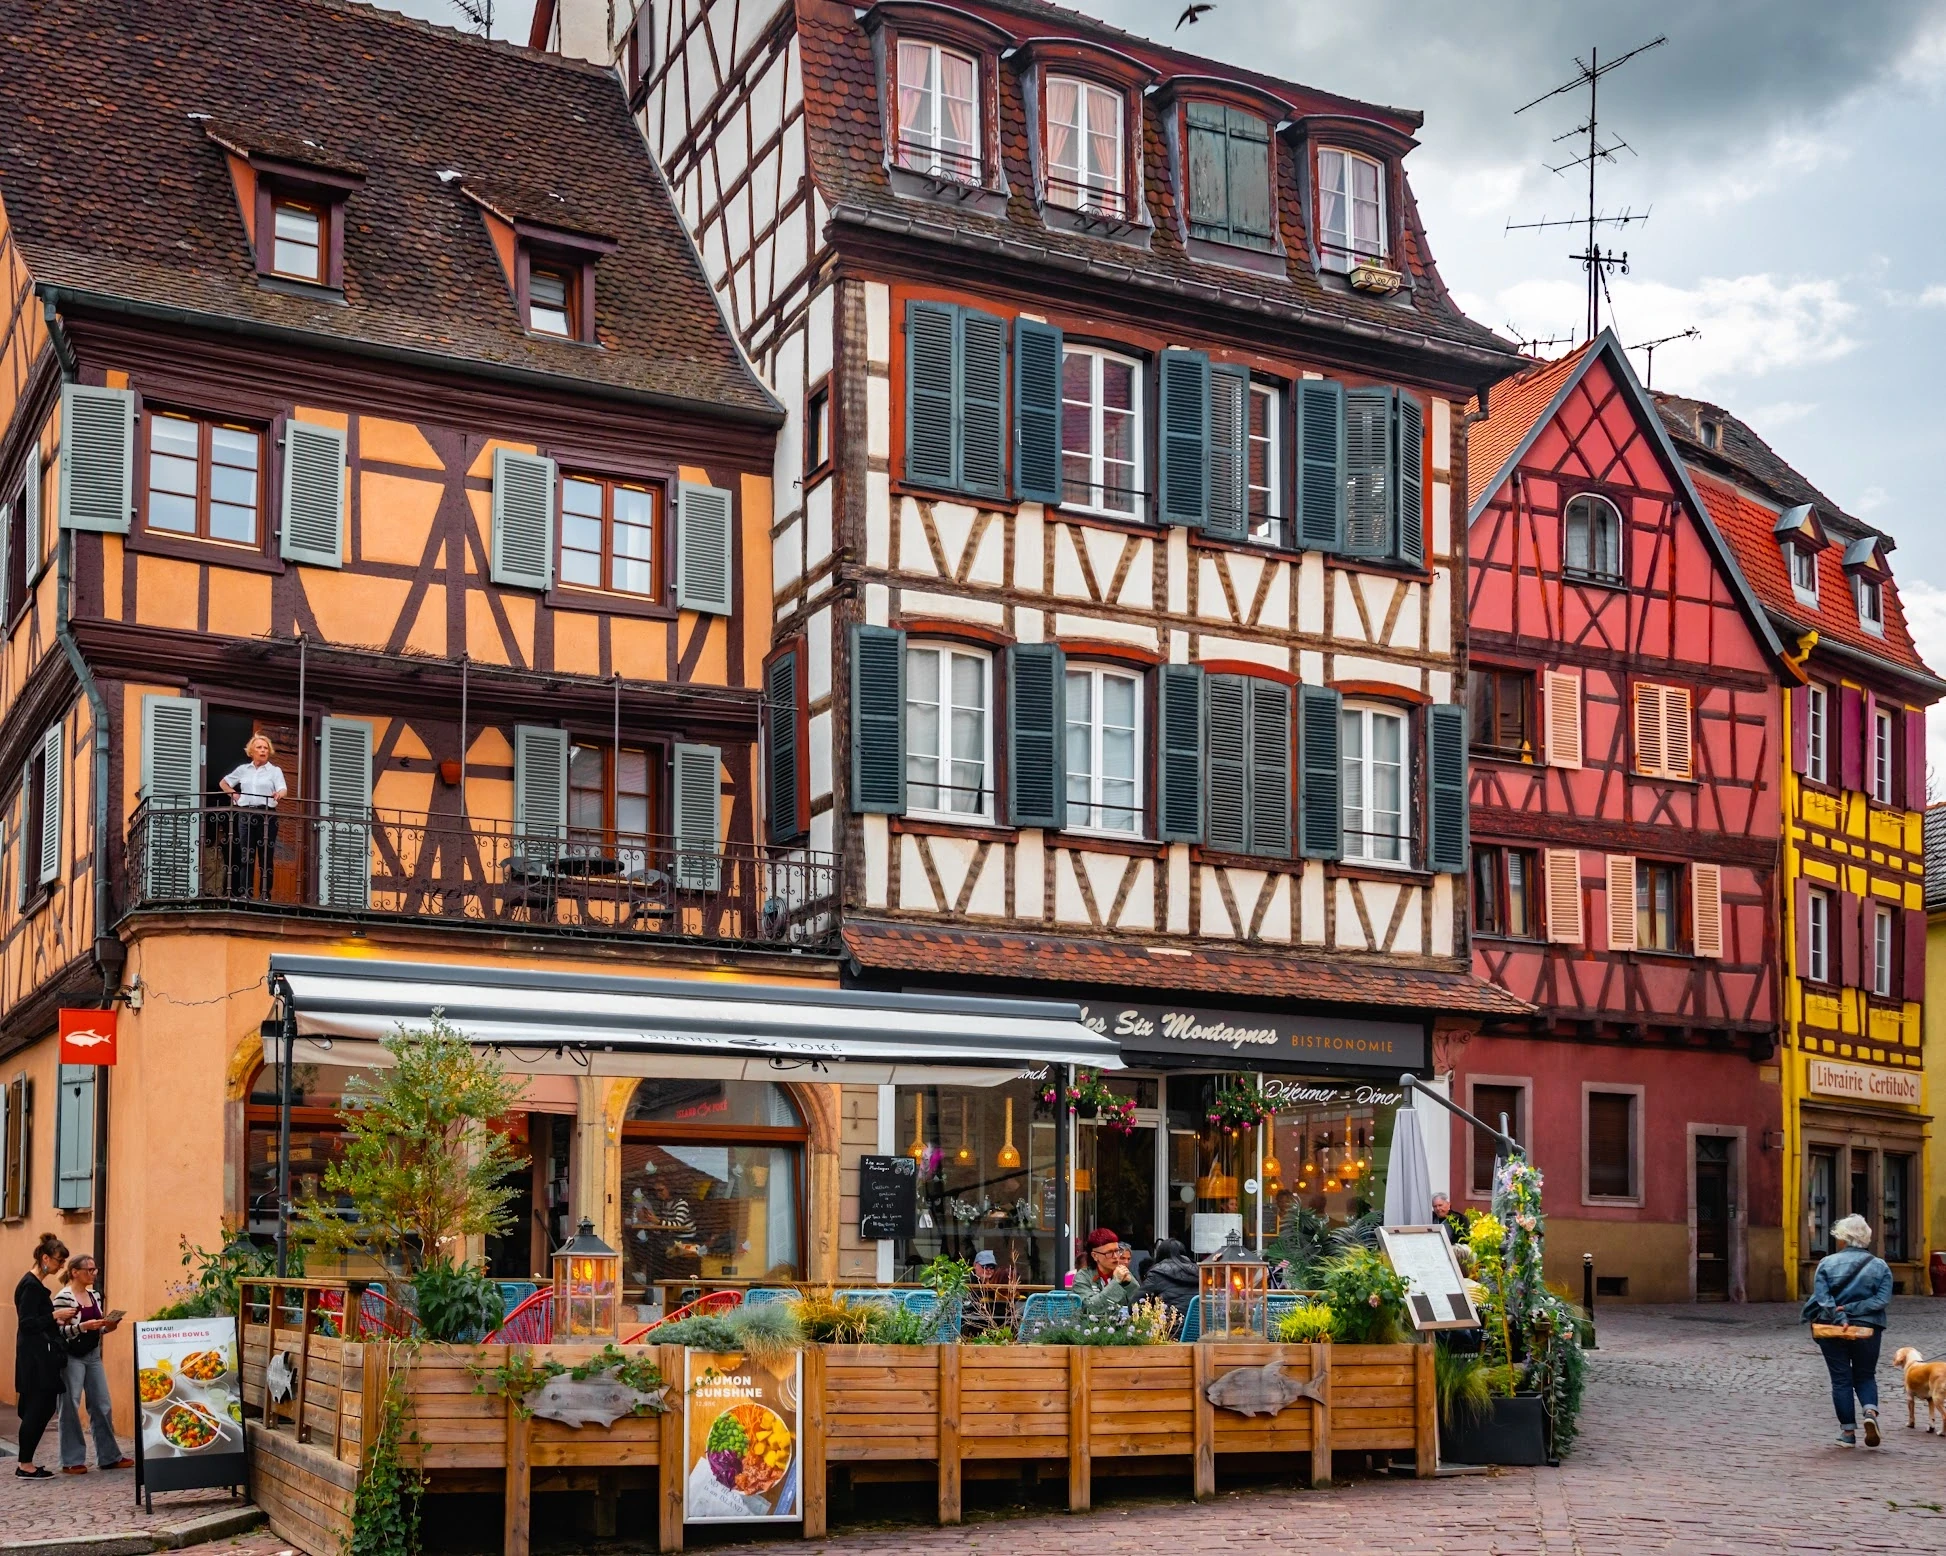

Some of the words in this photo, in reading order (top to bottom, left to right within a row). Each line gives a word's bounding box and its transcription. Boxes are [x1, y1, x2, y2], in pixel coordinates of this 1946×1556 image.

[1114, 1010, 1154, 1036] Six
[1161, 1012, 1279, 1049] Montagnes
[1291, 1034, 1393, 1053] BISTRONOMIE
[1264, 1079, 1338, 1102] Déjeuner
[1817, 1065, 1863, 1092] Librairie
[1868, 1072, 1916, 1098] Certitude
[607, 1193, 612, 1204] 1
[142, 1332, 180, 1340] CHIRASHI
[182, 1330, 210, 1338] BOWLS
[695, 1387, 763, 1398] SUNSHINE
